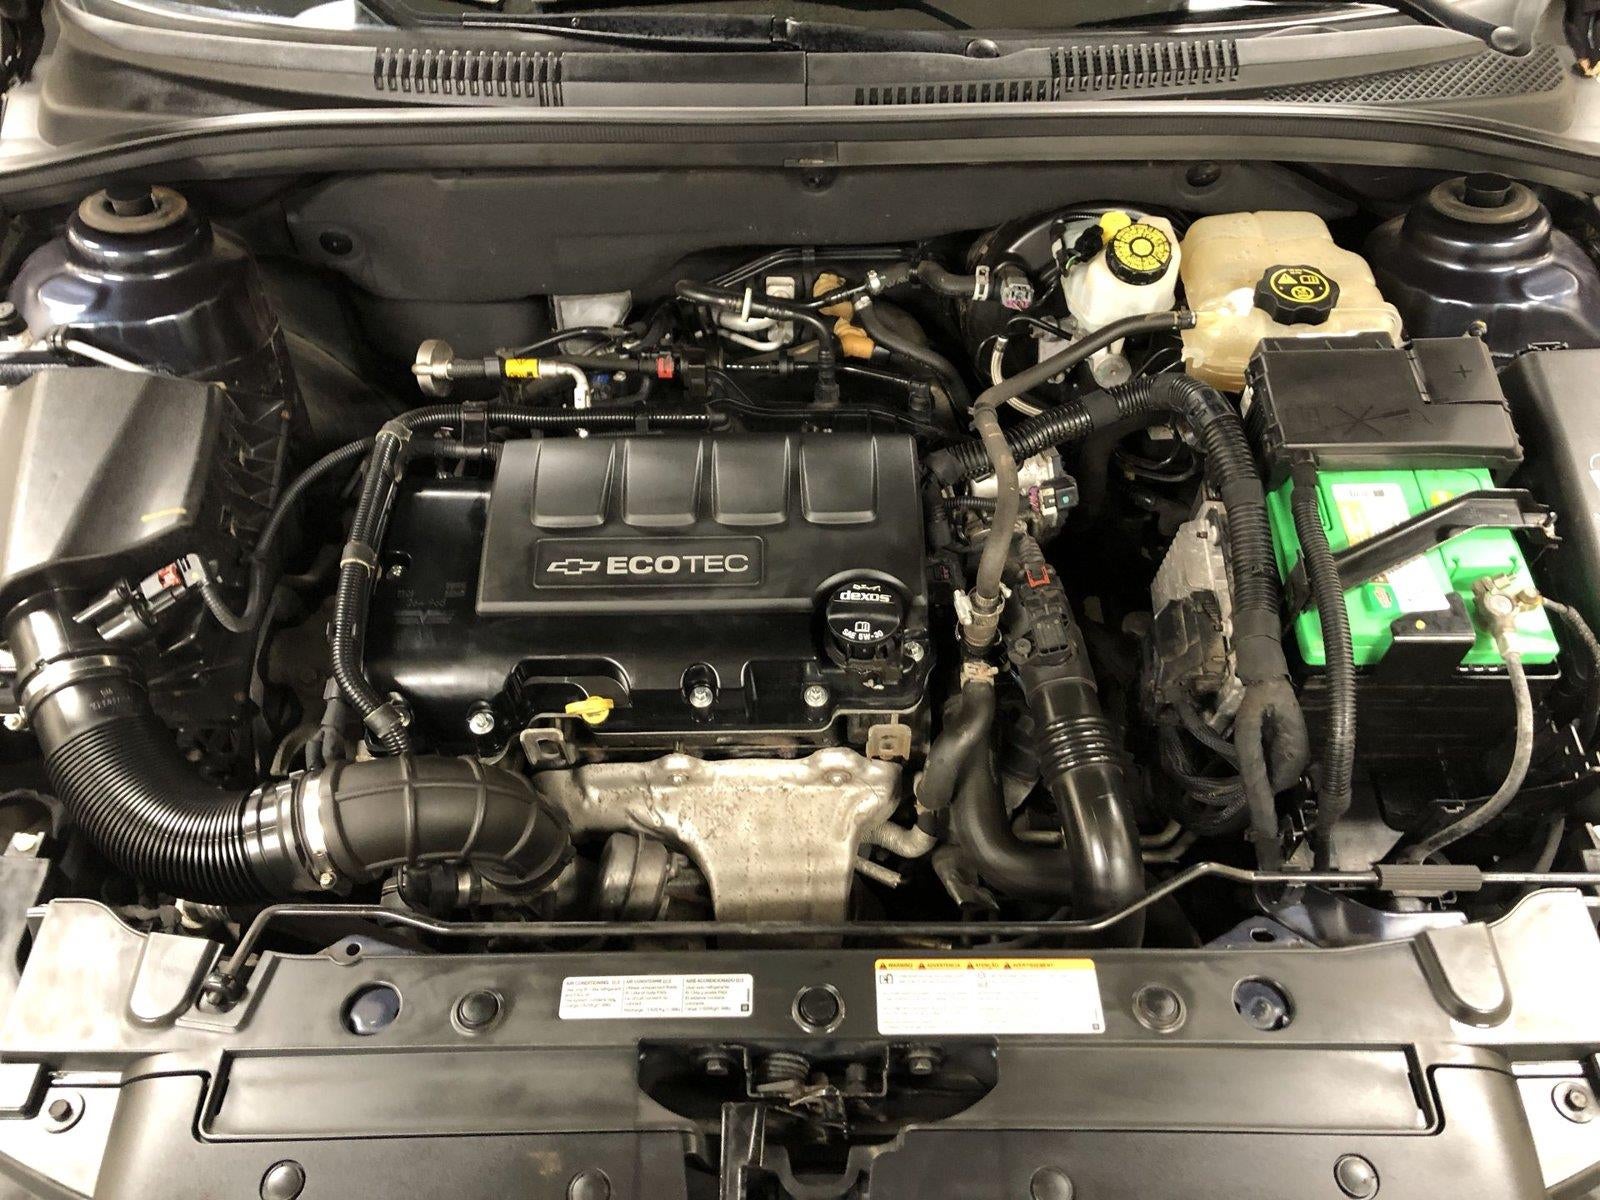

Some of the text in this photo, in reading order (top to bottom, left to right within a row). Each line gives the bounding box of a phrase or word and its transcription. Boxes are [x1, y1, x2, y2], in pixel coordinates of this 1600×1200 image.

[606, 554, 749, 575] ECOTEC
[839, 589, 892, 603] dexos
[842, 628, 884, 641] SAE 5W-30
